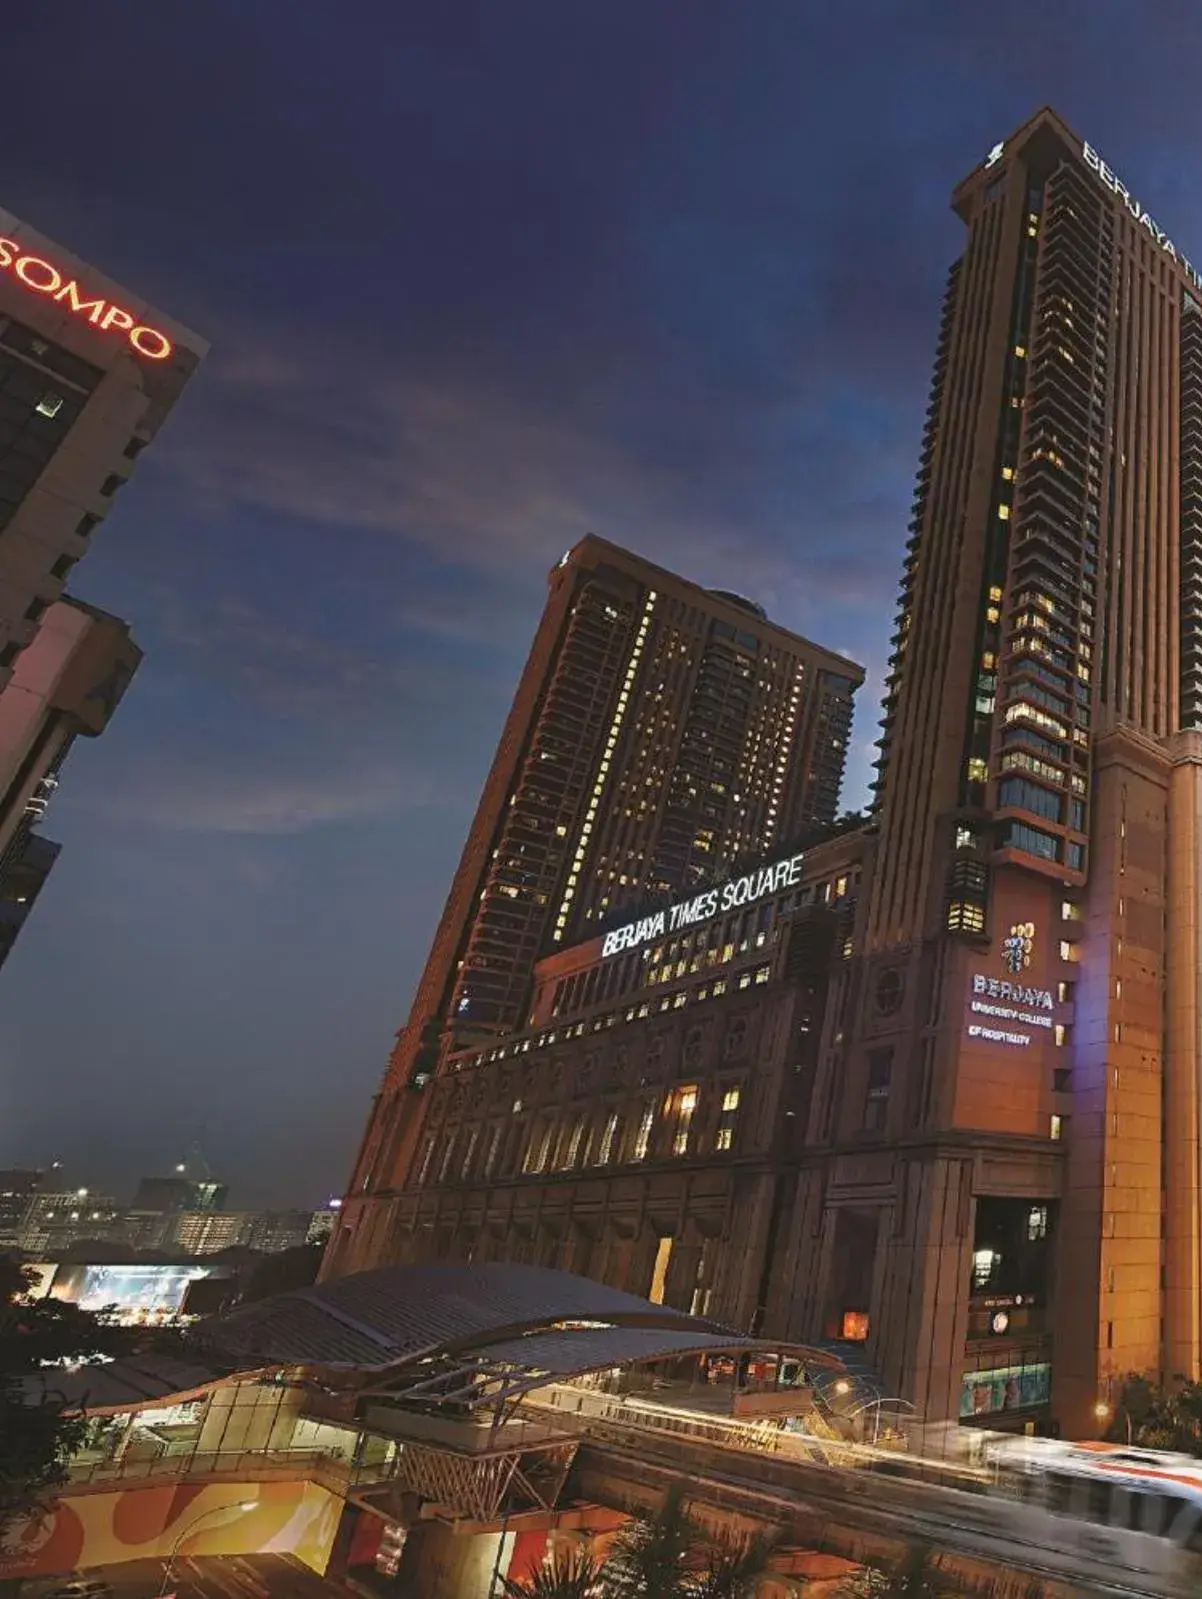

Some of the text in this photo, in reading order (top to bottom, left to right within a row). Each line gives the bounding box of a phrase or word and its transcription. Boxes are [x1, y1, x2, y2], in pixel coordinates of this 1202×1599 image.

[1083, 140, 1177, 264] BERJAYA
[0, 237, 171, 359] SOMPO
[602, 854, 804, 958] BERJAYA TIMES SQUARE
[971, 1001, 1052, 1028] UNIVERSITY COLLEGE
[973, 973, 1053, 1009] BERJAYA
